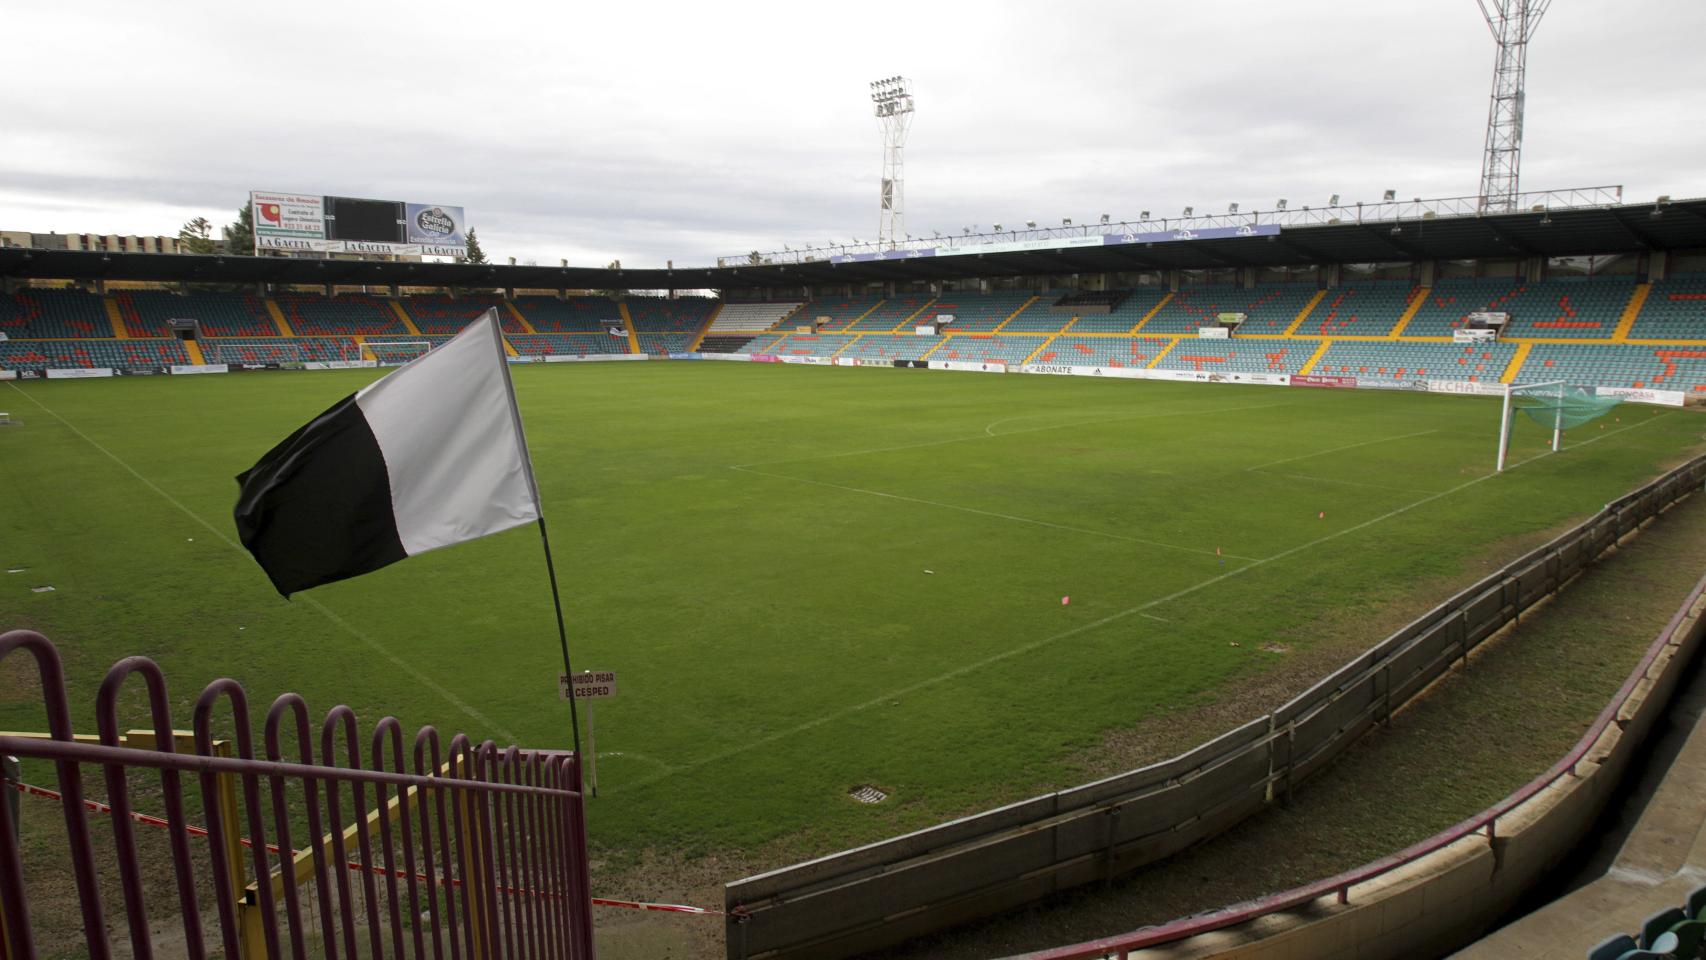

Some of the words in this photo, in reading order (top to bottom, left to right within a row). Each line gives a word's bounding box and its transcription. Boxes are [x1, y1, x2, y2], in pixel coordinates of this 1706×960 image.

[422, 212, 451, 227] Estrella
[422, 220, 449, 234] Galicia
[560, 674, 593, 685] PRHIBIDO
[596, 673, 613, 683] PISAR
[575, 686, 609, 697] CESPED
